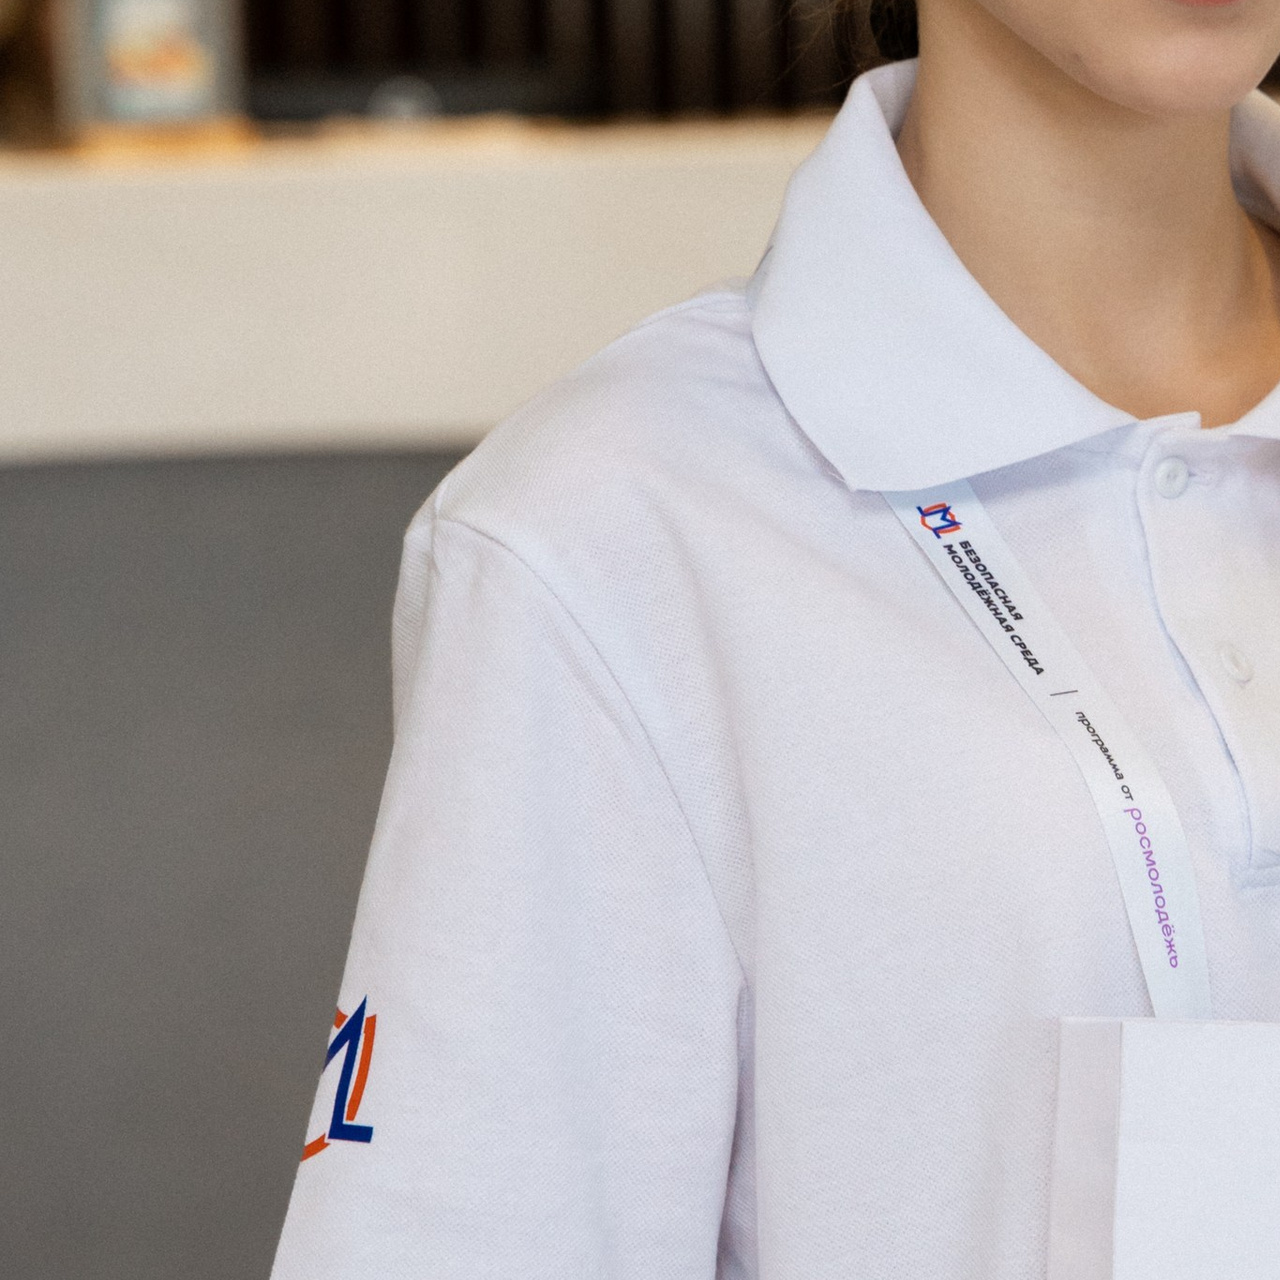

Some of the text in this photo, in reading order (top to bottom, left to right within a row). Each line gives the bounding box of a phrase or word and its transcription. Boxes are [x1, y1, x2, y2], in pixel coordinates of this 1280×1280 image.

[943, 544, 1045, 676] МОЛОДЁЖНАЯ СРЕДА
[959, 540, 1024, 621] БЕЗОПАСНАЯ
[1075, 710, 1179, 969] программа от росмолодёжь
